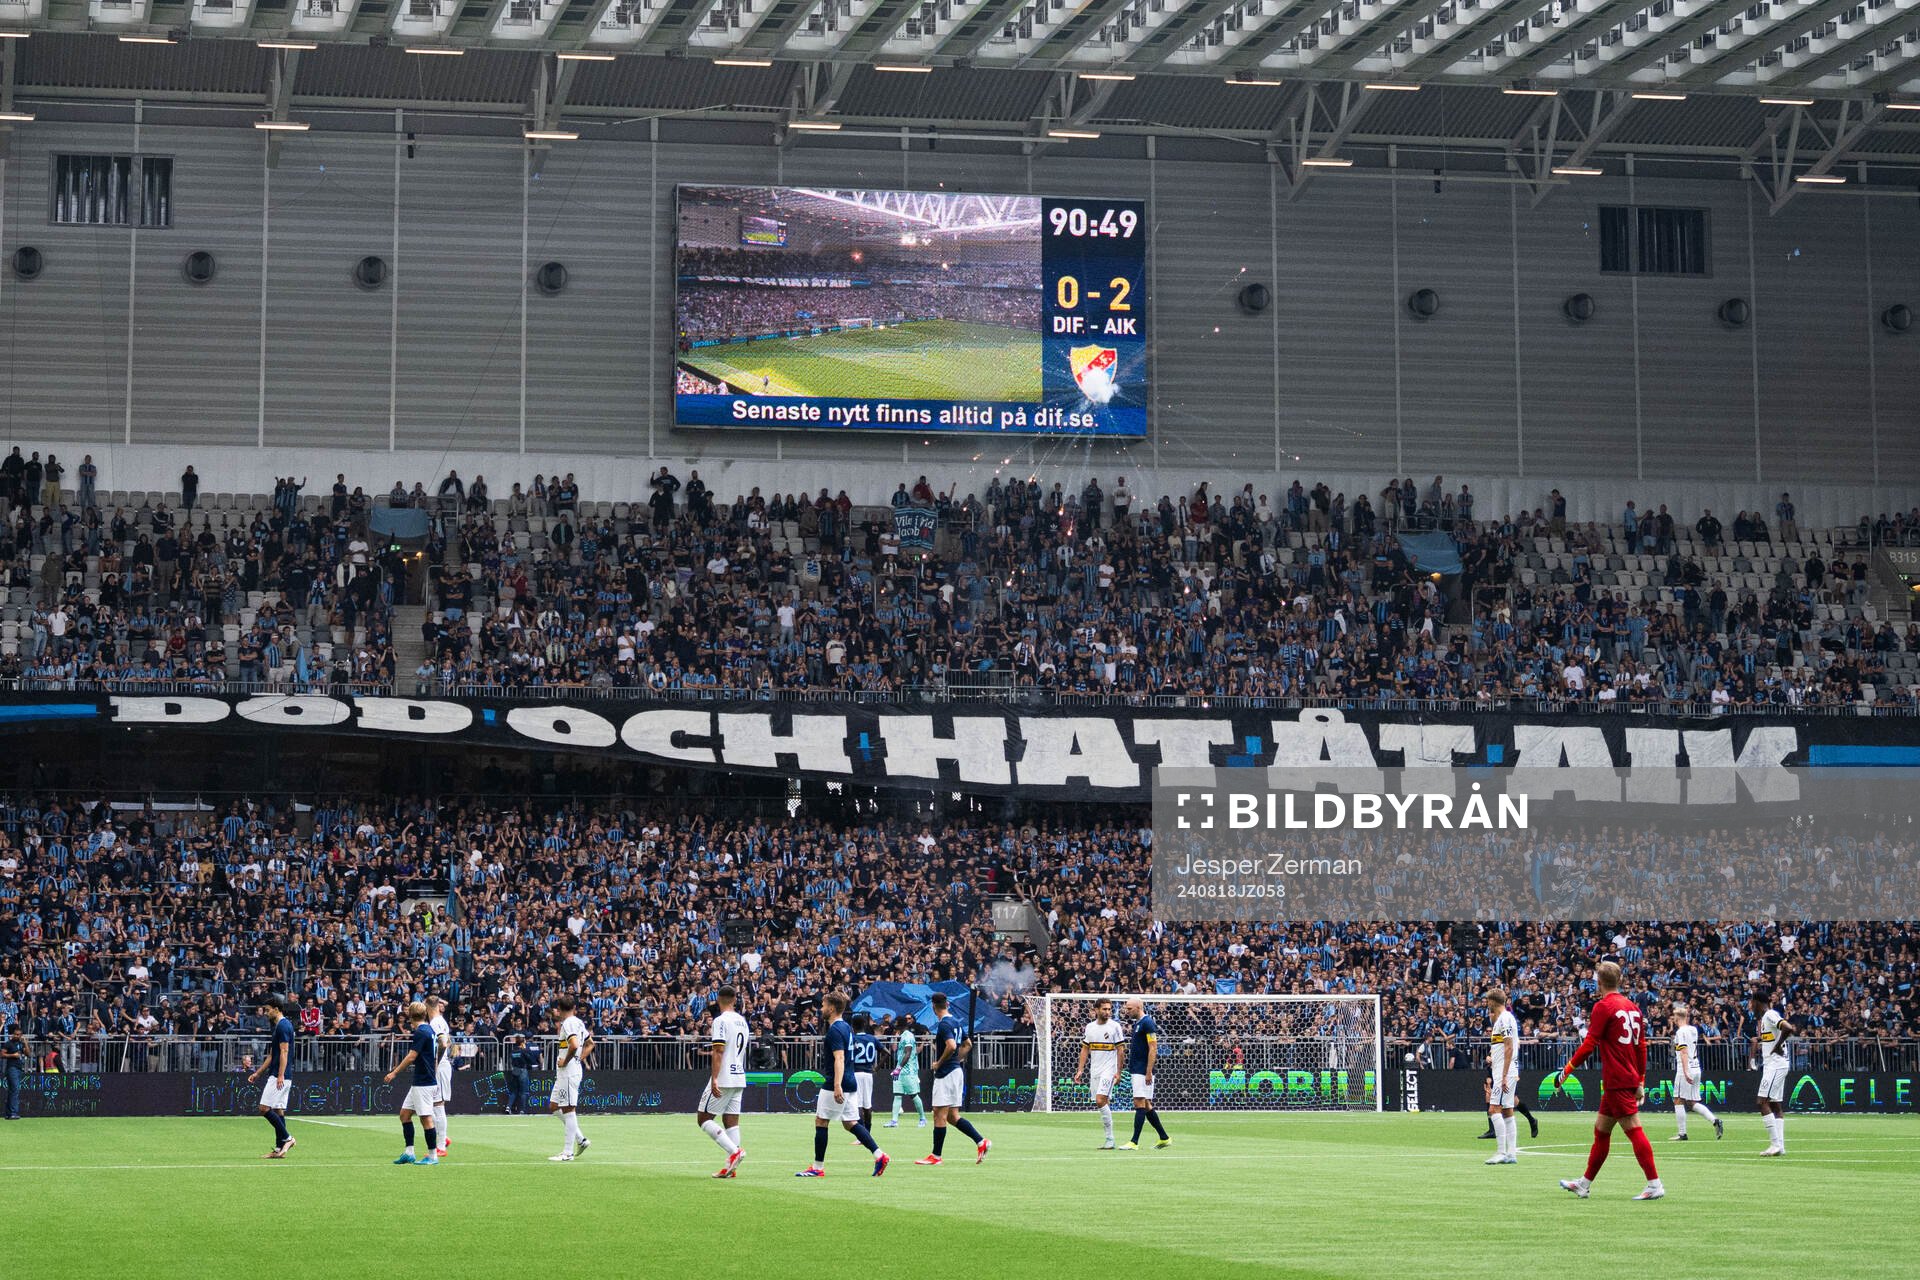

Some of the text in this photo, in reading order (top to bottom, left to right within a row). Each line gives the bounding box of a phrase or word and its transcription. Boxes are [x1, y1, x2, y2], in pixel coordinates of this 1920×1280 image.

[1049, 207, 1138, 238] 90:49
[1057, 275, 1079, 309] 0
[1109, 277, 1131, 311] 2
[1103, 318, 1137, 335] AIK
[732, 400, 821, 421] Senaste
[828, 404, 870, 426] nytt
[876, 404, 932, 424] finns
[939, 405, 993, 425] alltid
[1001, 406, 1028, 429] på
[506, 706, 852, 775] OCH
[878, 714, 1237, 788] HAT
[1267, 707, 1475, 800] ÅT
[1505, 725, 1801, 806] AIK
[1615, 1009, 1641, 1046] 35
[736, 1032, 744, 1057] 9
[854, 1042, 876, 1064] 20
